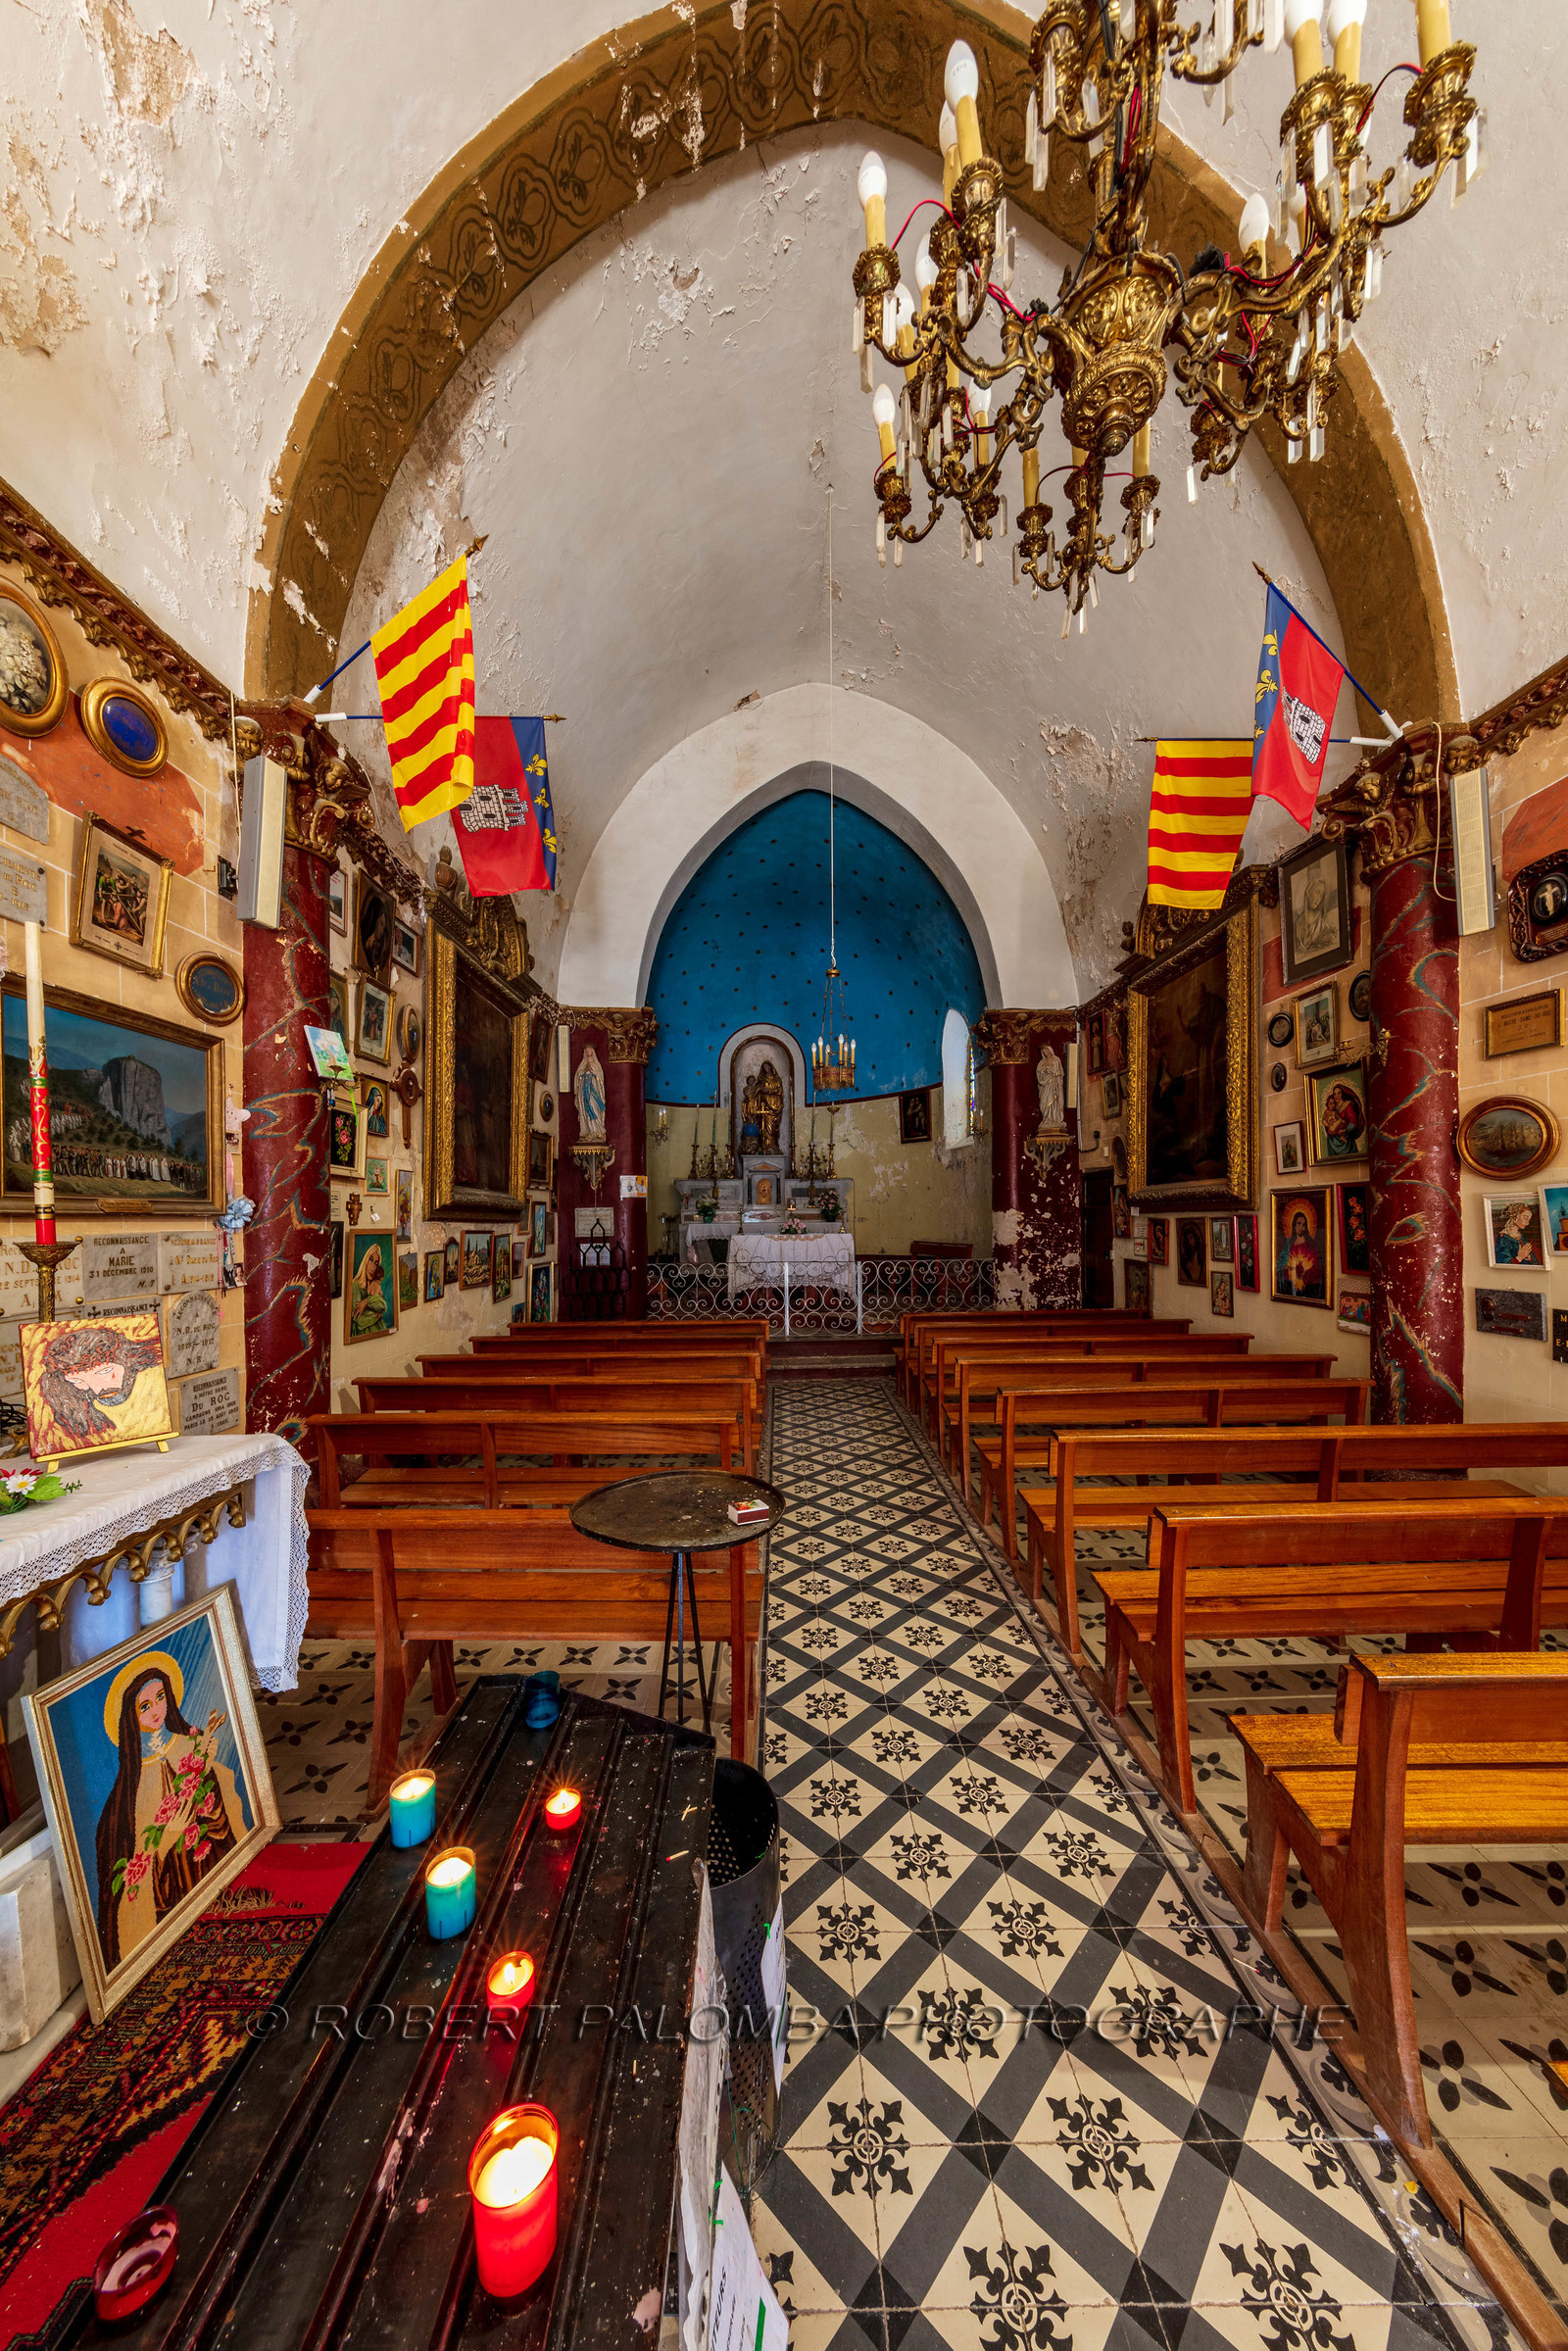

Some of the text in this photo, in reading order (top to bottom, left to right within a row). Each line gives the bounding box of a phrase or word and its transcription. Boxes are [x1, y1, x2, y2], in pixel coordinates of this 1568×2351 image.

[93, 1236, 150, 1247] RECONNAISSANCE
[109, 1255, 135, 1267] MARIE
[89, 1270, 100, 1279] 31
[102, 1266, 137, 1278] DÉCEMBRE
[103, 1302, 149, 1317] RECONNAISSANCE
[193, 1376, 227, 1393] RECONNAISSANCE
[199, 1390, 213, 1398] NOTRE
[215, 1385, 226, 1394] DAME
[211, 1392, 230, 1406] ROC
[186, 1409, 211, 1423] CAMPAGNE
[184, 1421, 198, 1431] PARIS
